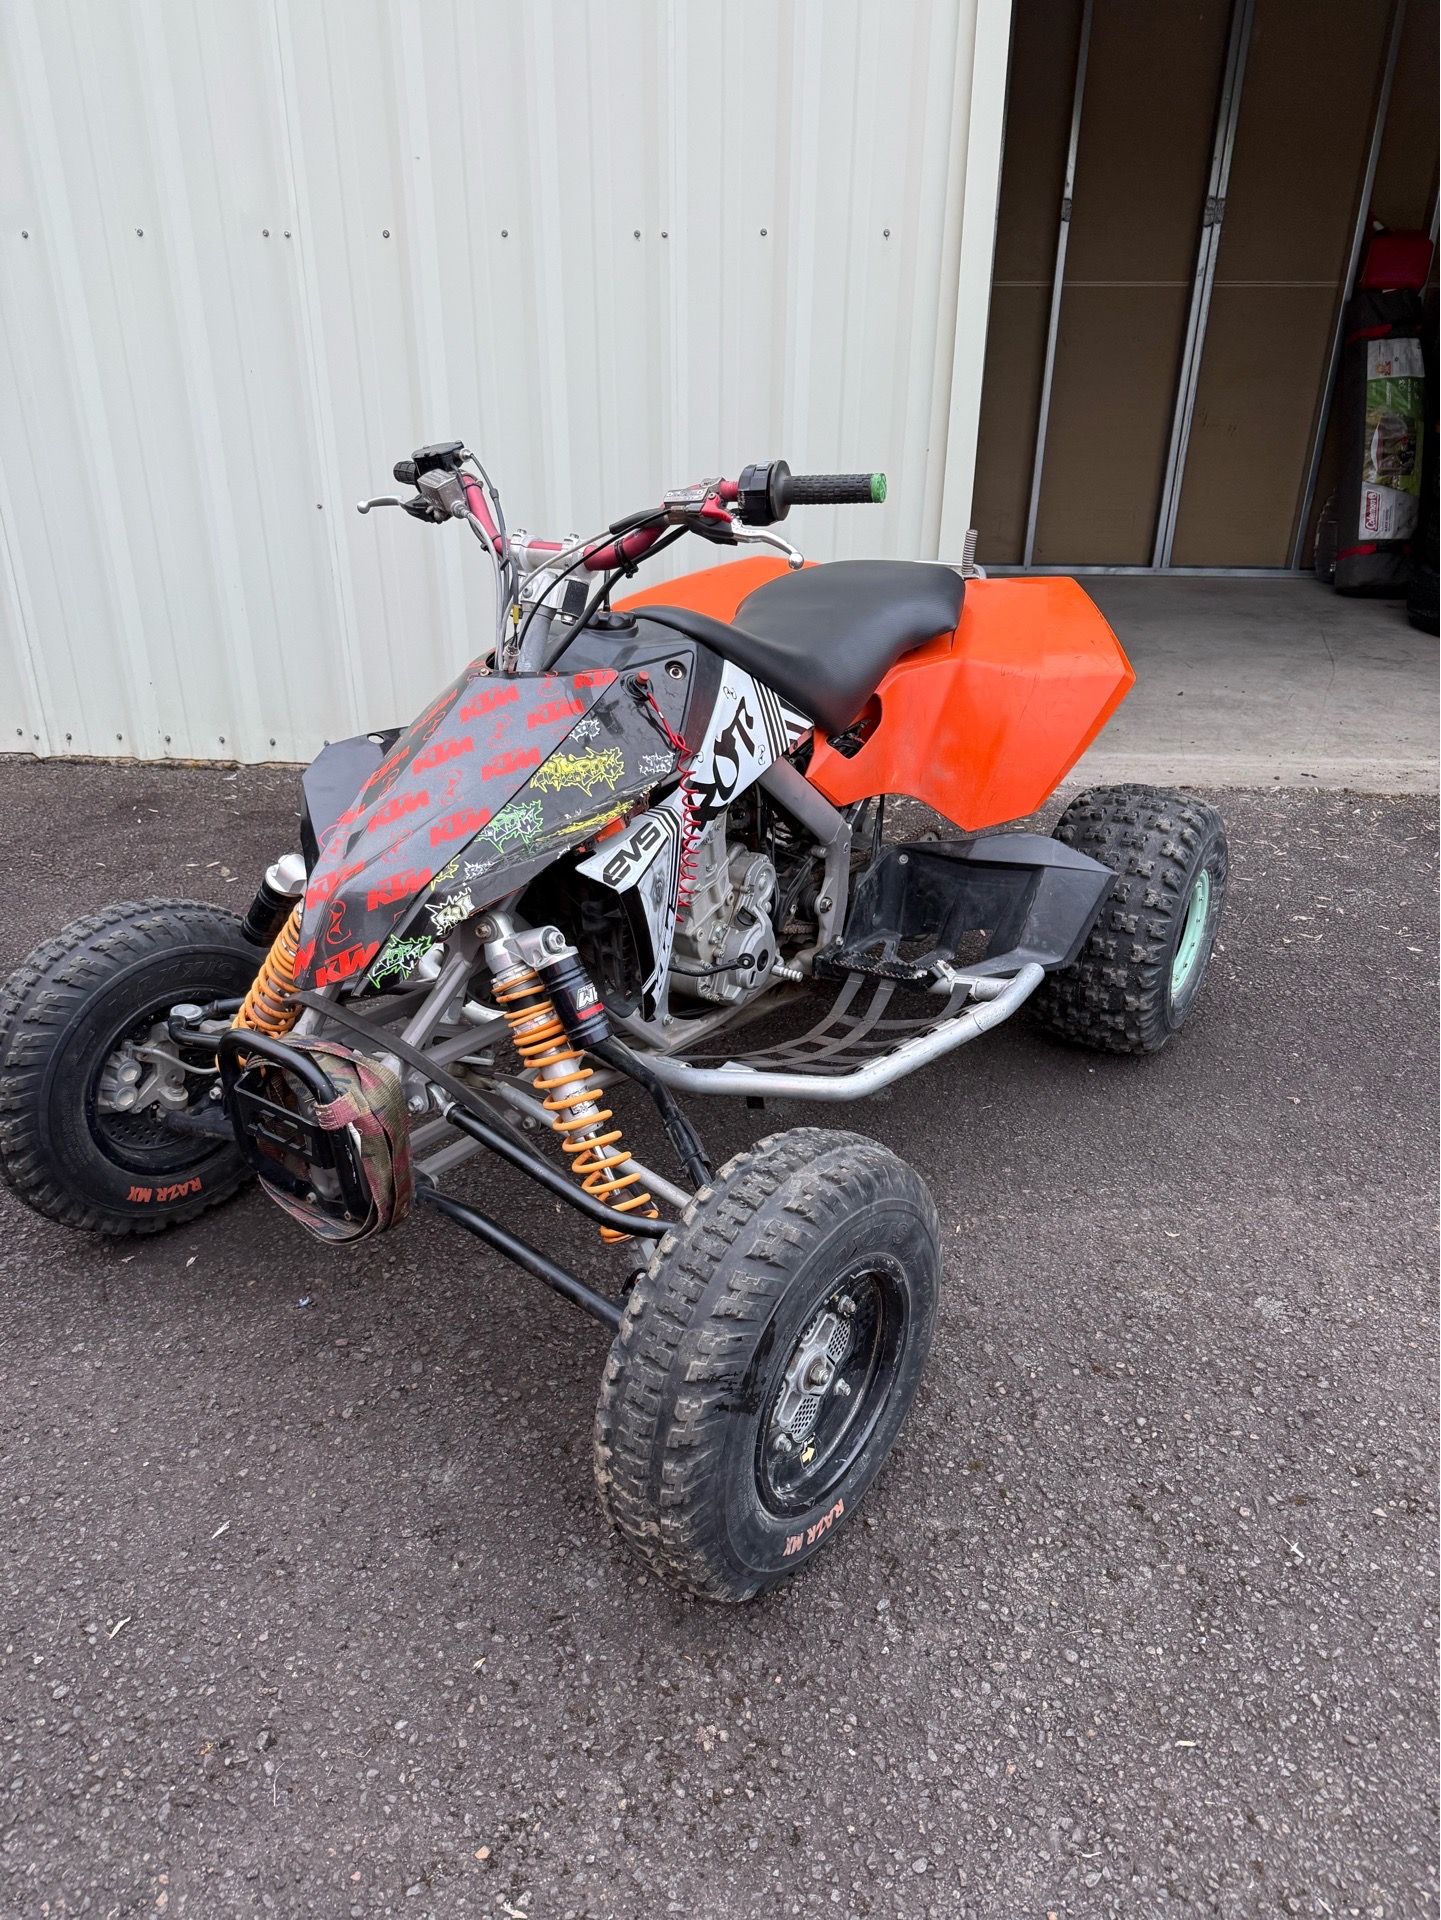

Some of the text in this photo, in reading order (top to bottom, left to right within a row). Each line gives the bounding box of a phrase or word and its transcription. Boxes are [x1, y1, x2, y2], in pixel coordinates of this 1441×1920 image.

[459, 684, 520, 724] KTM
[527, 697, 585, 731] KTM
[412, 736, 474, 776] KTM
[481, 746, 542, 782] KTM
[367, 790, 430, 833] KTM
[430, 807, 492, 849] KTM
[603, 821, 662, 887] EVS
[367, 866, 433, 912] KTM
[315, 940, 380, 988] KTM
[126, 1177, 202, 1203] RAZR MX
[782, 1498, 844, 1557] RAZR MX
